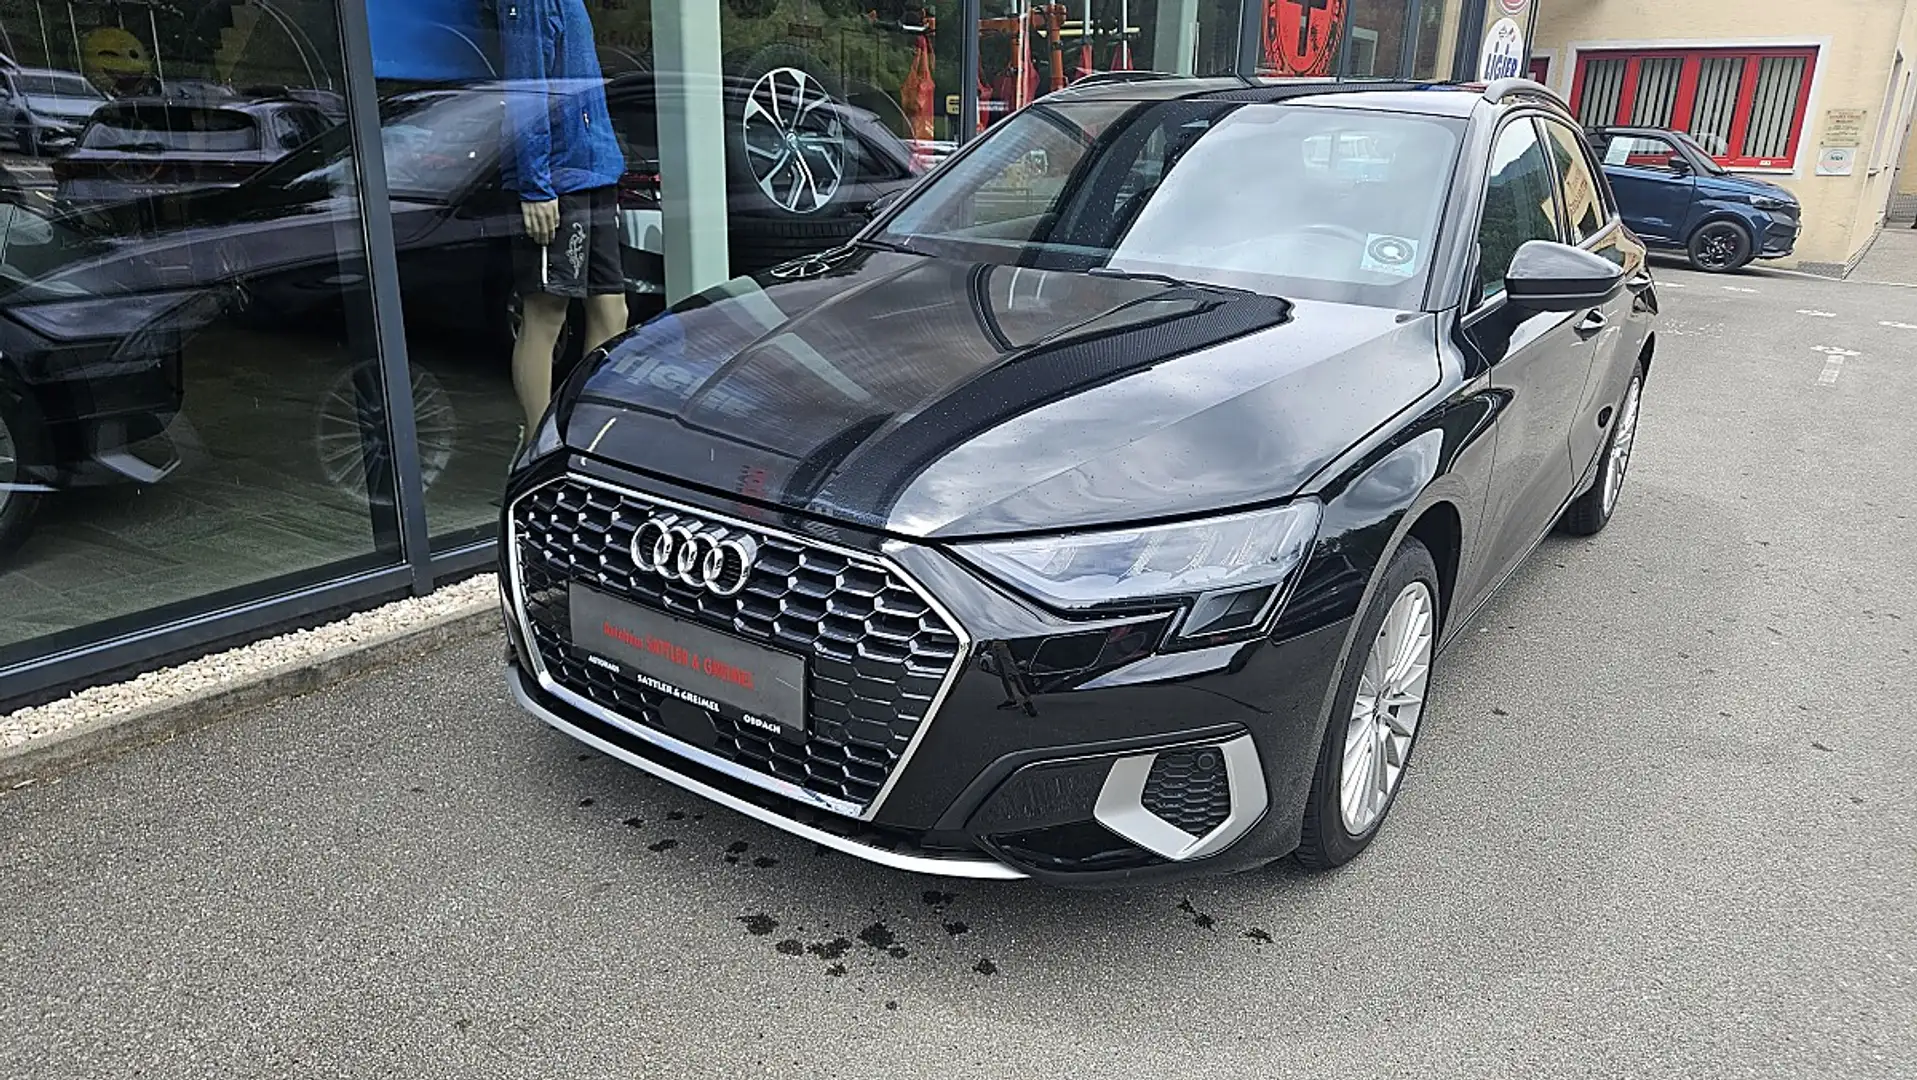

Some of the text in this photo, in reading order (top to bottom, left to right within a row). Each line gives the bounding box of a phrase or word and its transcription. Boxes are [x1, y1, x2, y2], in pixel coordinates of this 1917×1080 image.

[1484, 53, 1519, 80] LIGIER
[637, 674, 720, 713] SATTLER & GREIMEL
